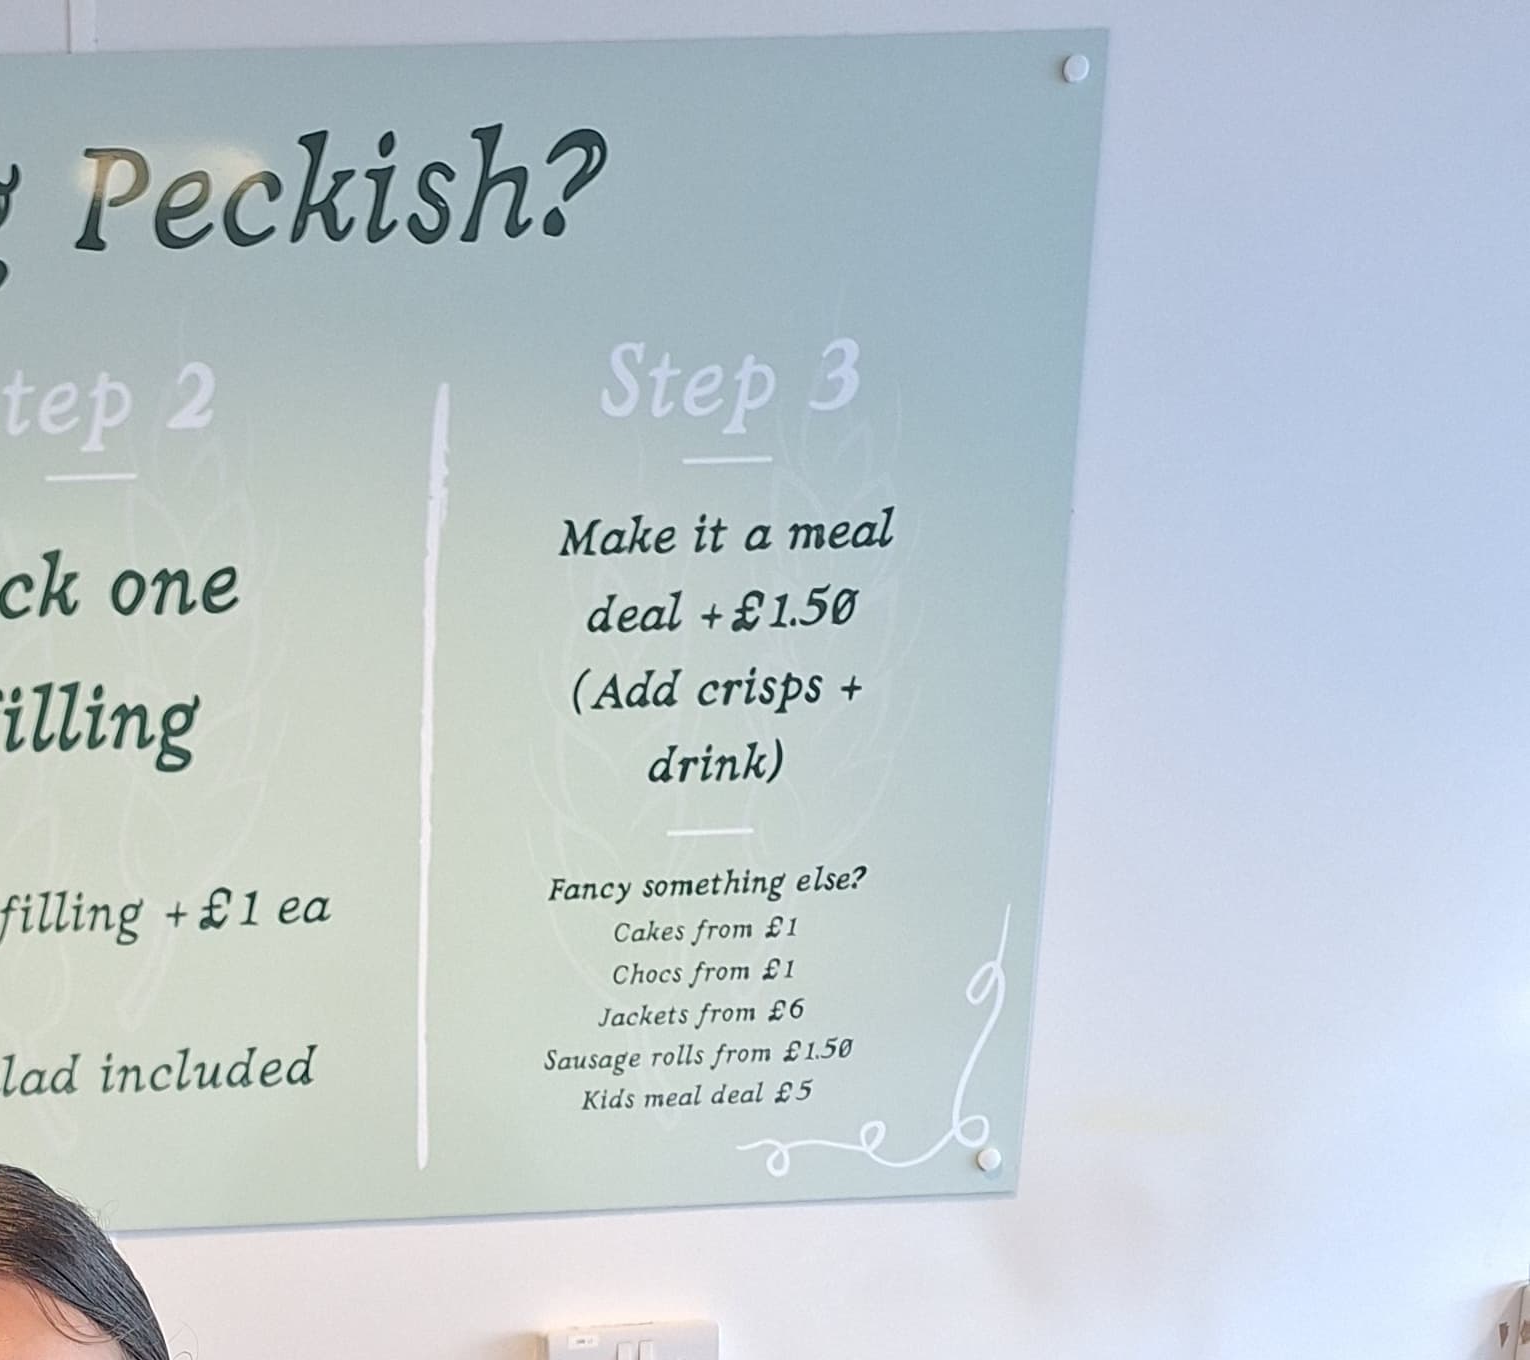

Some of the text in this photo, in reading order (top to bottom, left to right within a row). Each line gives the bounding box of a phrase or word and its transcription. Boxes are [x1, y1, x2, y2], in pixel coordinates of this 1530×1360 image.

[74, 122, 608, 252] Peckish?
[165, 361, 216, 430] 2
[600, 337, 860, 435] Step 3
[558, 505, 895, 557] Make it a meal
[110, 565, 239, 617] one
[586, 583, 860, 633] deal +£1.50
[573, 666, 863, 715] (Add crisps +
[647, 738, 783, 784] drink)
[165, 886, 258, 931] +£1
[278, 896, 331, 925] ea
[548, 865, 868, 905] Fancy something else?
[614, 915, 797, 947] Cakes from £1
[612, 957, 794, 989] Chocs from £1
[597, 997, 805, 1030] Jackets from £6
[101, 1044, 319, 1094] included
[544, 1037, 854, 1077] Sausage rolls from £1.50
[581, 1079, 813, 1111] Kids meal deal £5
